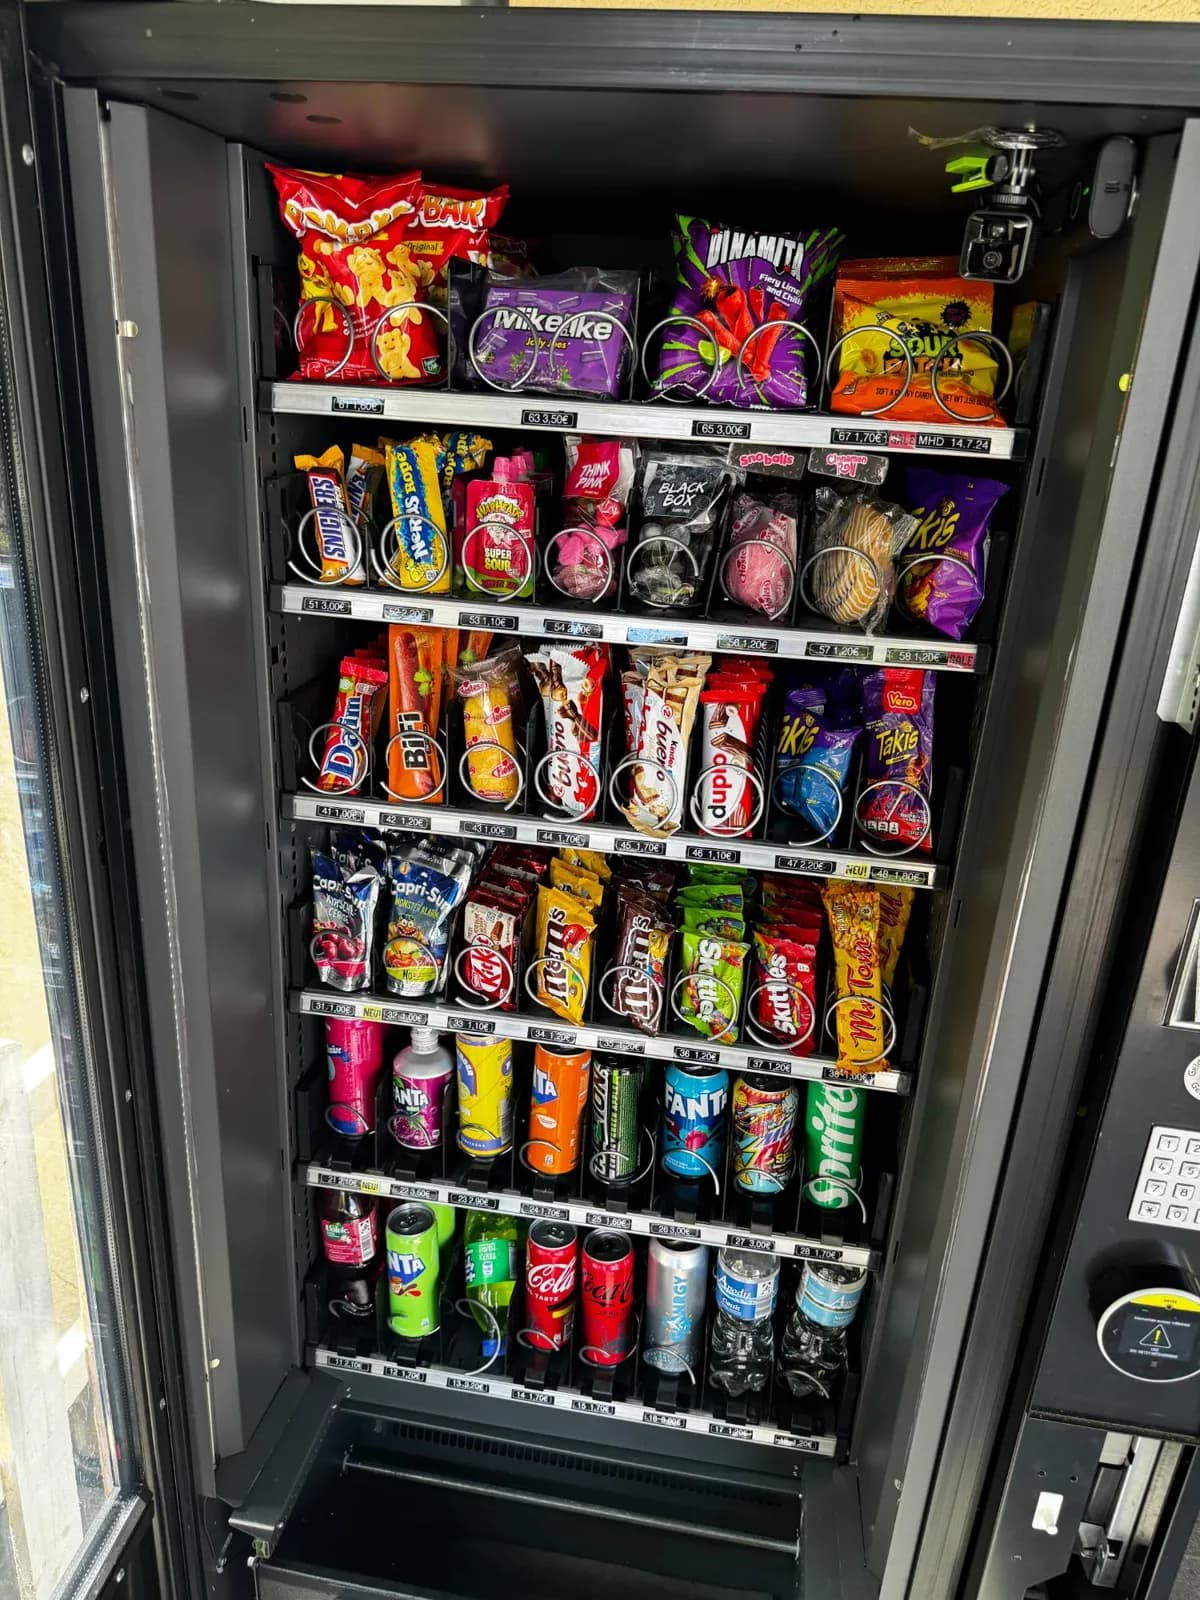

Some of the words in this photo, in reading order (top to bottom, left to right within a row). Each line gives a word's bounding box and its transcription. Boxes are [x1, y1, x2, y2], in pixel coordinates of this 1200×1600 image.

[760, 273, 781, 288] Fiery
[781, 280, 801, 295] Lime
[766, 286, 781, 296] and
[494, 306, 562, 332] Mike
[569, 312, 613, 341] Ike
[525, 337, 546, 349] Joly
[889, 335, 958, 357] SOUR
[528, 413, 540, 423] 63
[542, 414, 568, 425] 3,50€
[702, 423, 714, 433] 65
[716, 424, 743, 436] 3,00€
[838, 430, 851, 440] 67
[855, 431, 882, 443] 1,70€
[918, 437, 945, 447] MHD
[951, 438, 989, 450] 14.7.24
[581, 460, 611, 477] THINK
[575, 476, 608, 489] PINK
[658, 481, 708, 494] BLACK
[662, 494, 697, 507] BOX
[312, 477, 346, 559] SNICKERS
[484, 547, 512, 560] SUPER
[484, 558, 511, 571] SOUR
[308, 601, 319, 609] 51
[321, 602, 345, 612] 3,00€
[469, 615, 480, 624] 53
[483, 616, 506, 627] 1,10€
[554, 623, 565, 632] 54
[743, 639, 768, 650] 1,20€
[819, 645, 831, 654] 57
[834, 646, 859, 657] 1,20€
[899, 652, 911, 661] 58
[915, 652, 940, 663] 1,20€
[888, 692, 915, 709] Vero
[320, 694, 363, 785] Daim
[875, 729, 919, 761] Takis
[322, 806, 332, 815] 41
[386, 815, 397, 824] 42
[402, 816, 424, 827] 1,20€
[472, 824, 482, 832] 43
[485, 825, 505, 835] 1,00€
[543, 833, 553, 841] 44
[620, 841, 631, 850] 45
[637, 842, 659, 853] 1,70€
[692, 849, 703, 857] 46
[708, 849, 731, 860] 1,10€
[787, 859, 798, 868] 47
[799, 860, 823, 871] 2,20€
[846, 865, 867, 876] NEU!
[876, 870, 888, 879] 48
[847, 935, 874, 992] Tom
[696, 939, 722, 1023] Skttles
[363, 1006, 381, 1018] NEU!
[468, 1020, 489, 1031] 1,10€
[535, 1030, 545, 1038] 34
[695, 1051, 716, 1061] 1,20€
[752, 1060, 762, 1068] 37
[768, 1061, 790, 1073] 1,20€
[809, 1083, 859, 1209] Sprite
[735, 1237, 745, 1246] 27
[749, 1239, 770, 1250] 3,00€
[800, 1247, 810, 1256] 28
[814, 1248, 836, 1259] 1,70€
